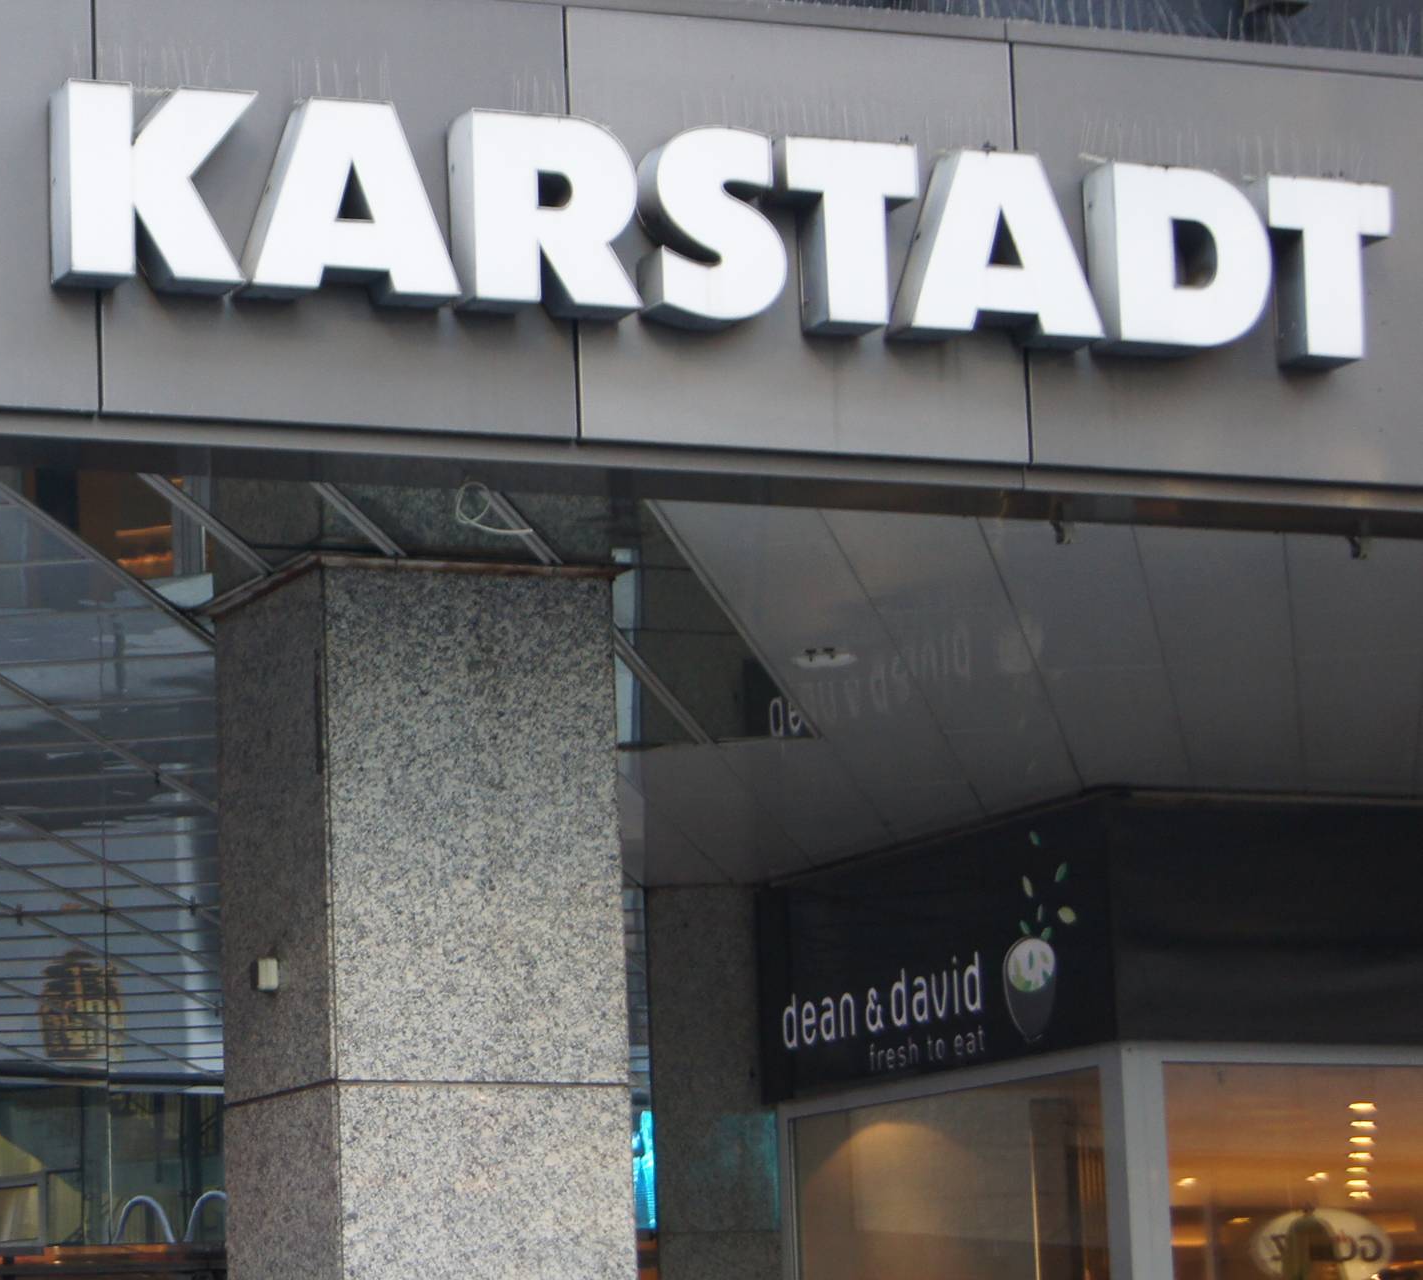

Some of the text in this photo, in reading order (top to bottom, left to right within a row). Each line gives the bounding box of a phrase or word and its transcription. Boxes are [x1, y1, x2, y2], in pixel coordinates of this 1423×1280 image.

[51, 80, 1392, 369] KARSTADT
[782, 951, 981, 1049] dean & david
[870, 1025, 985, 1071] fresh to eat
